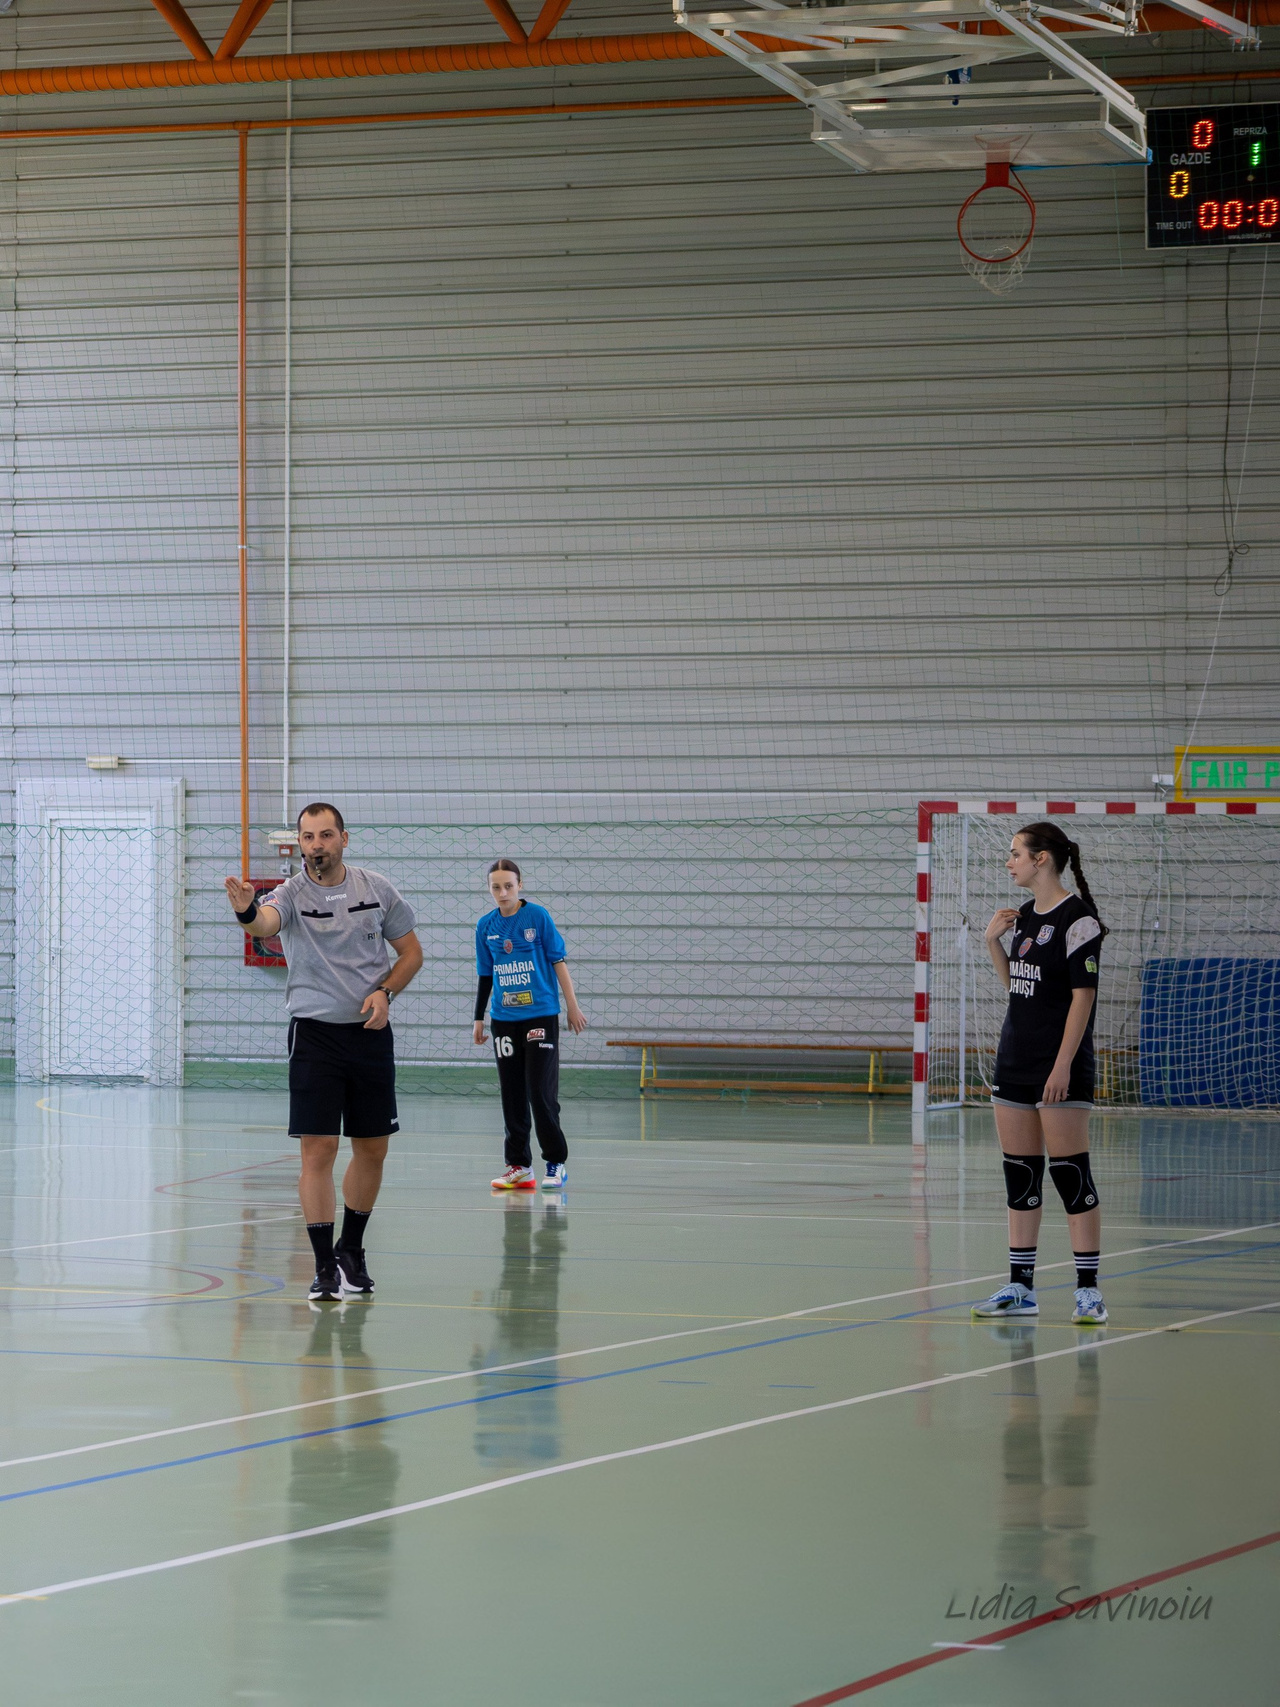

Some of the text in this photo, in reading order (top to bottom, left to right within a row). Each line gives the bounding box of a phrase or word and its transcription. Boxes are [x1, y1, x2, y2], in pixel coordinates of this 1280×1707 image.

[1193, 120, 1214, 148] 0
[1233, 127, 1268, 136] REPRIZA
[1170, 152, 1211, 165] GAZDE
[1251, 142, 1261, 166] 1
[1169, 170, 1190, 198] 0
[1156, 221, 1192, 230] TIME OUT
[325, 893, 347, 902] Kempa
[493, 960, 535, 975] PRIMĂRIA
[499, 972, 531, 986] BUHUȘI
[495, 1035, 514, 1058] 16
